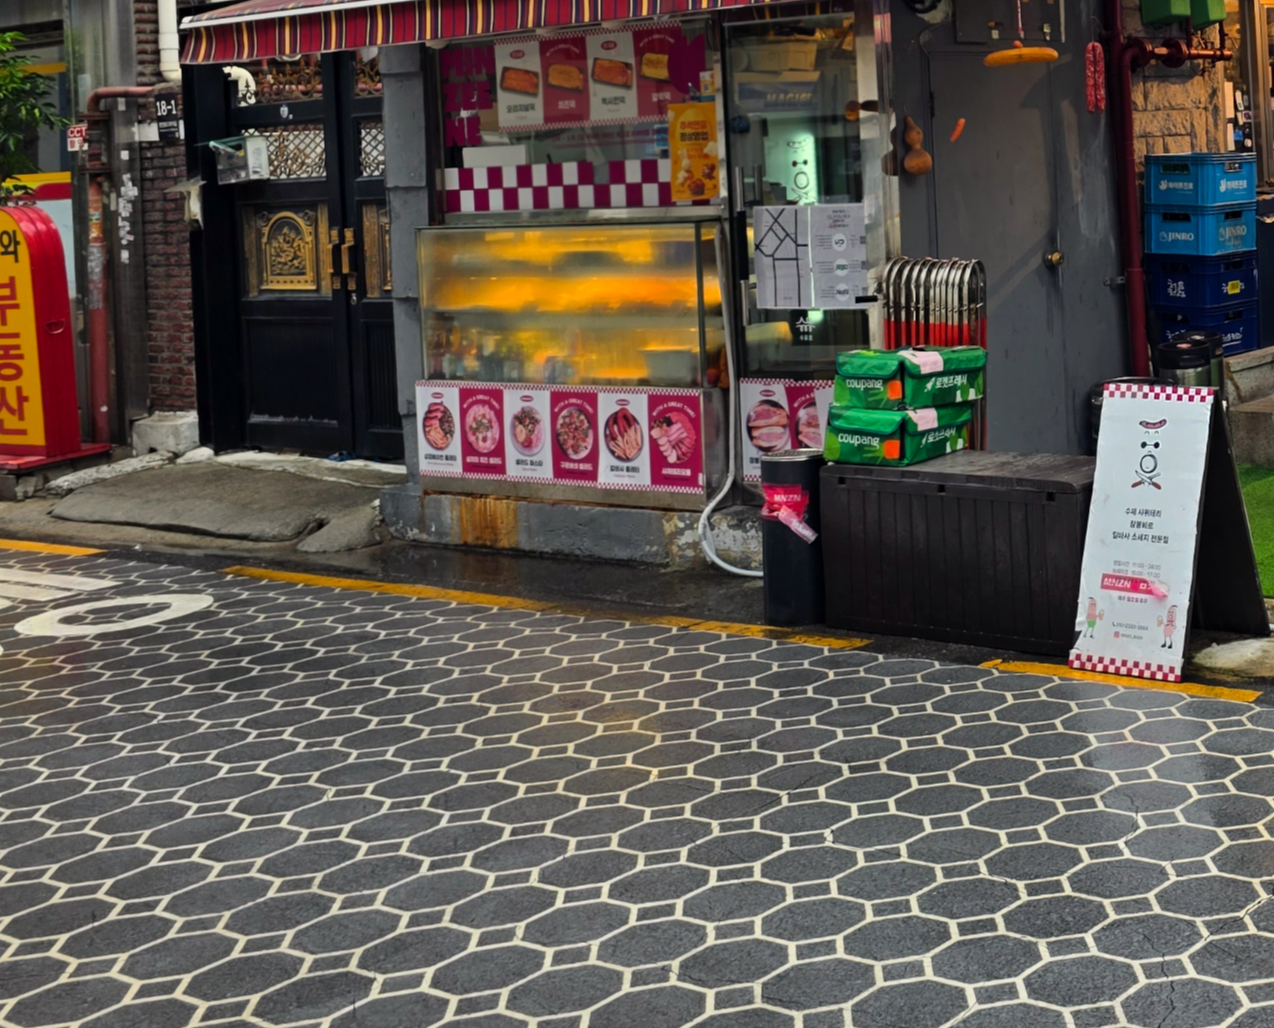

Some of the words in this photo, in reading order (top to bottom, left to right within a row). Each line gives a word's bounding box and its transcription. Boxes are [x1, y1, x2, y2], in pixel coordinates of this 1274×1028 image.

[156, 100, 177, 116] 18-1
[1168, 232, 1195, 242] JINRO
[1225, 225, 1247, 239] JINRO
[846, 378, 883, 391] coupang
[838, 432, 881, 449] coupang
[1150, 534, 1169, 544] 전문점
[1103, 577, 1131, 588] MNZN
